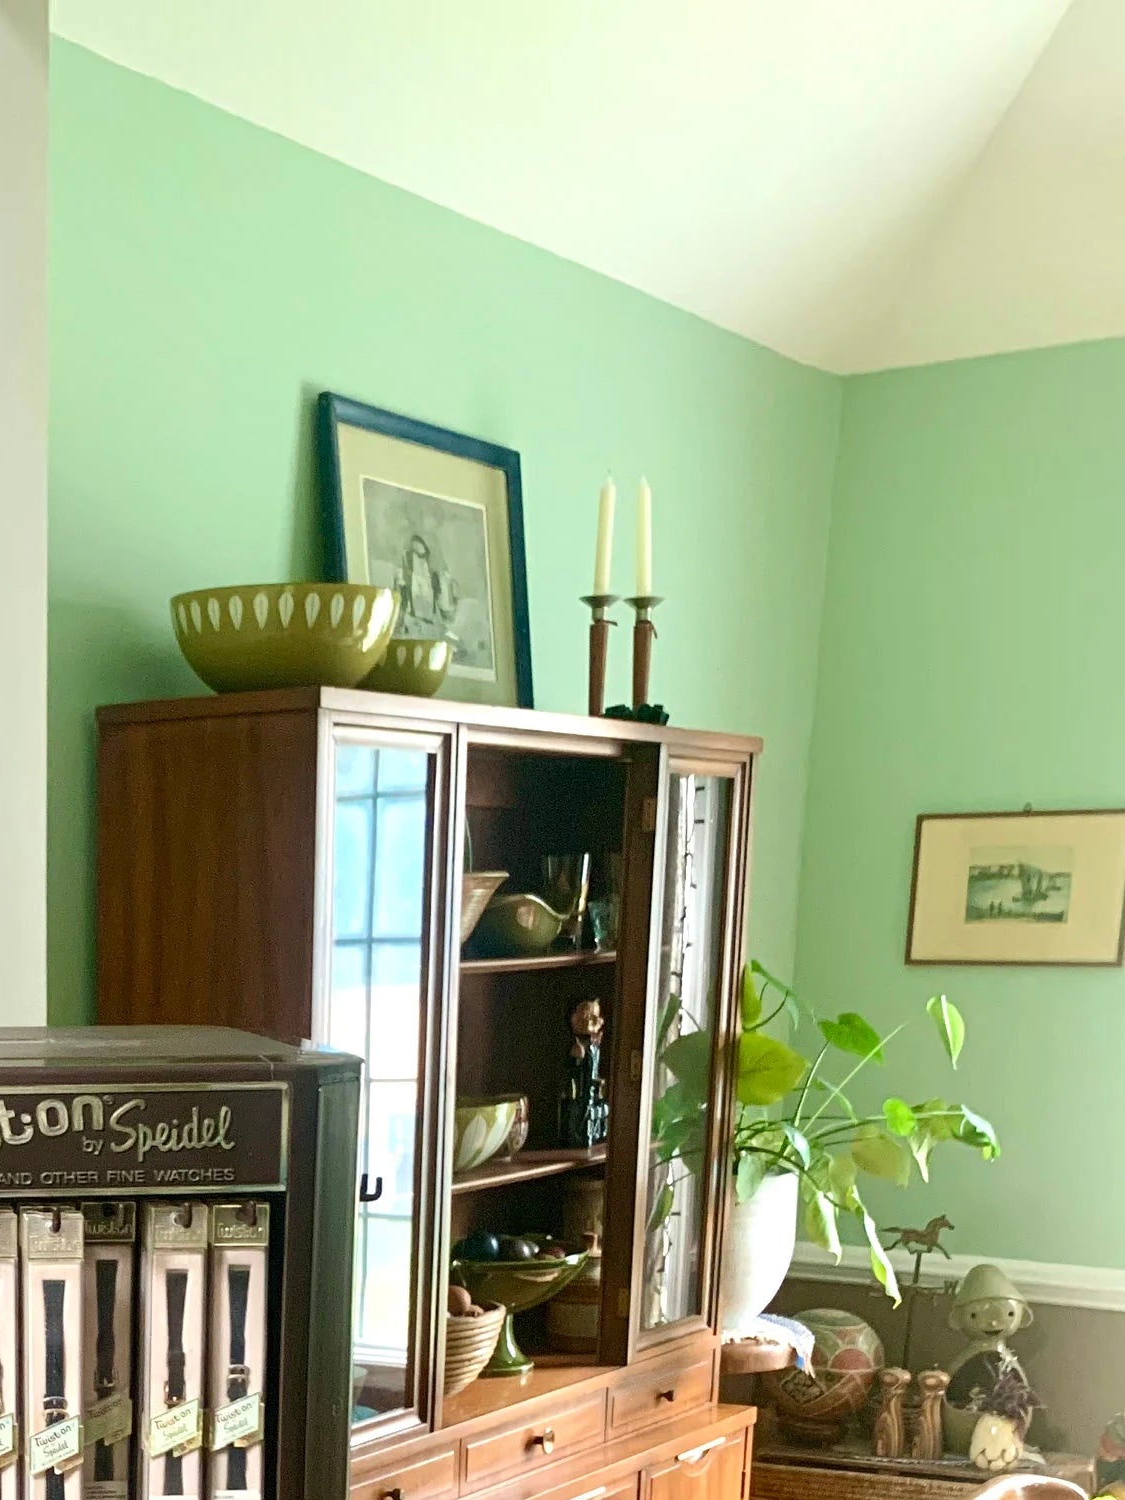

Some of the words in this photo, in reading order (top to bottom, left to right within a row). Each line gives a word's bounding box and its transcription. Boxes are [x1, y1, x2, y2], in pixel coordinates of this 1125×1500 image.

[82, 1136, 104, 1155] by
[110, 1099, 235, 1162] Speidel
[40, 1171, 98, 1185] OTHER
[107, 1170, 145, 1182] FINE
[153, 1168, 236, 1183] WATCHES
